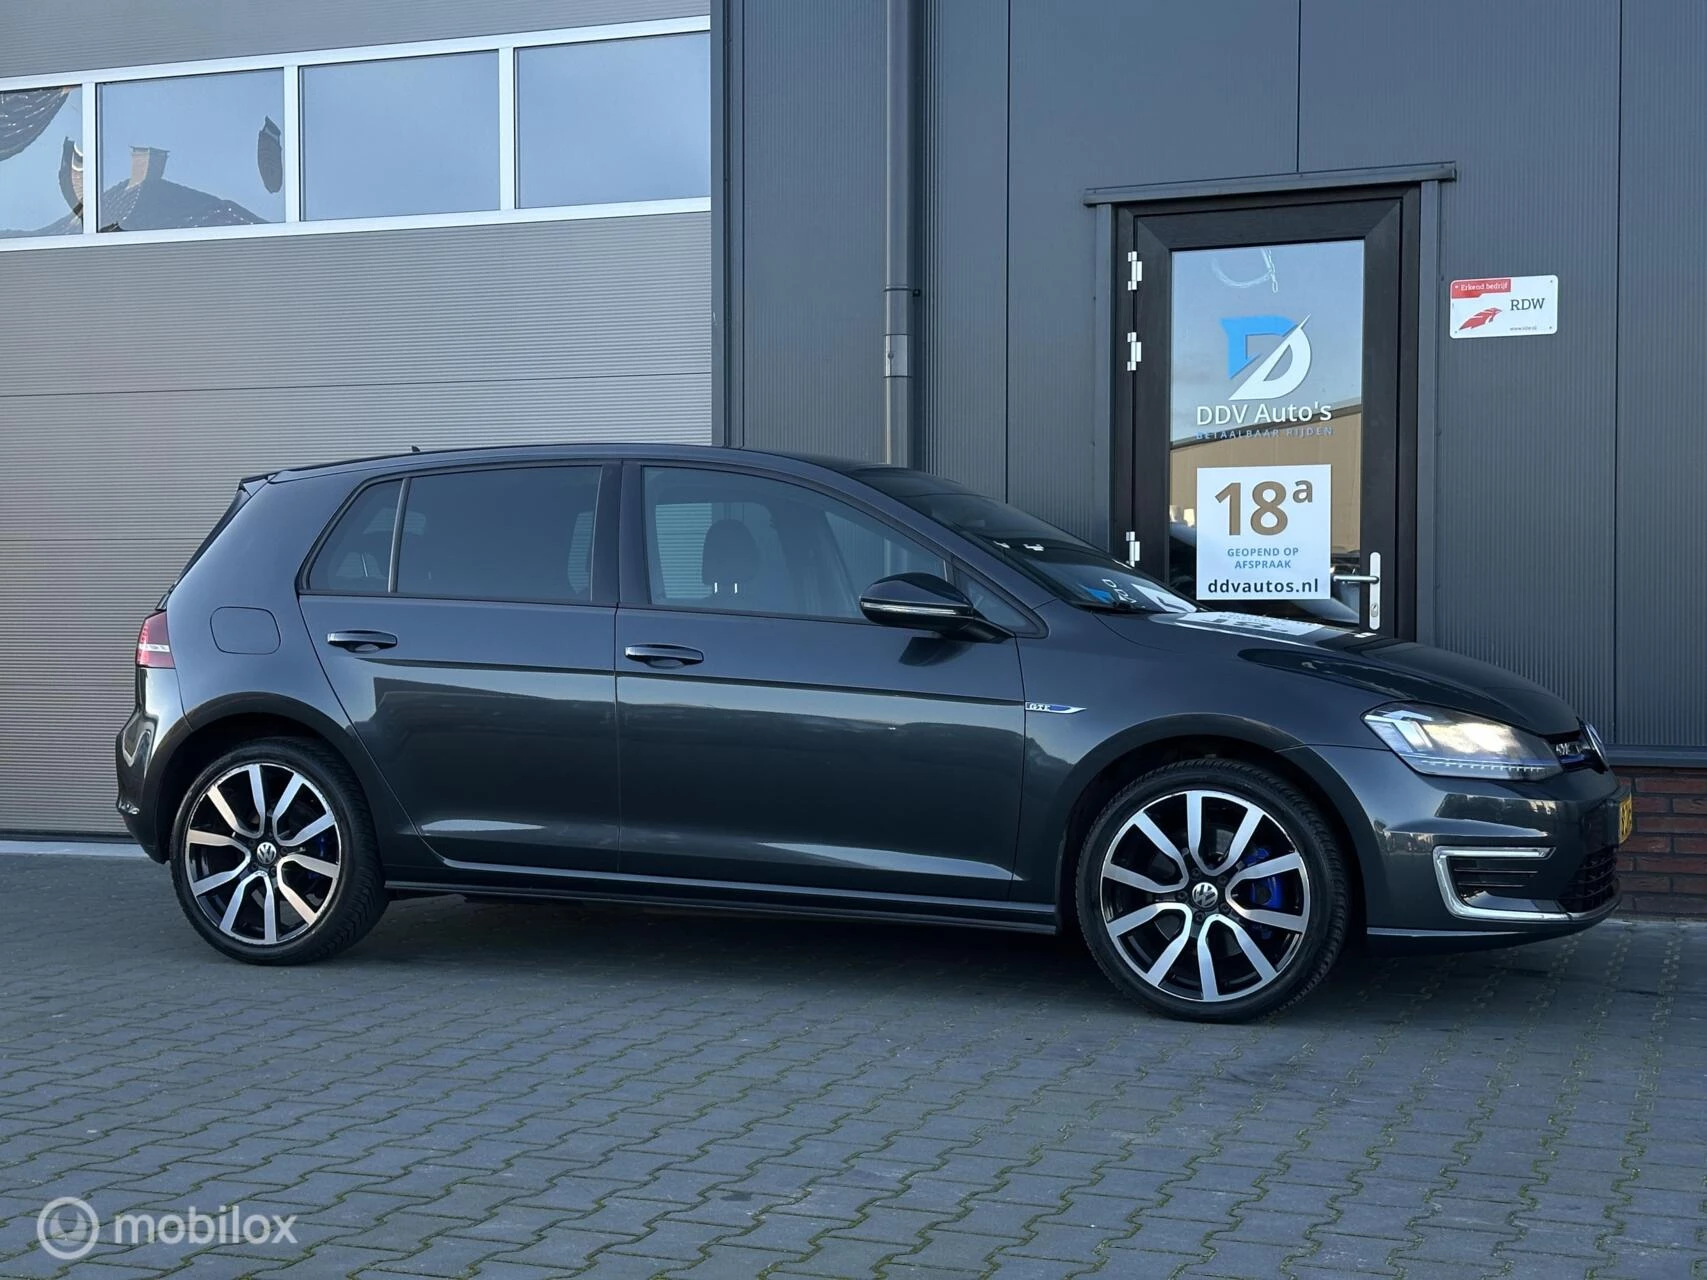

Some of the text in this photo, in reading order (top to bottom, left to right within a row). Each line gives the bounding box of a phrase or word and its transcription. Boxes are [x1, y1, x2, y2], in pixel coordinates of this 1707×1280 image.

[1460, 281, 1508, 292] Erkend bedrijf
[1510, 298, 1545, 311] RDW
[1196, 400, 1332, 425] DDV Auto's
[1195, 426, 1333, 440] BETAALBAAR RIJDEN
[1227, 547, 1299, 557] GEOPEND OP
[1234, 559, 1292, 569] AFSPRAAK
[1207, 578, 1319, 593] ddvautos.nl
